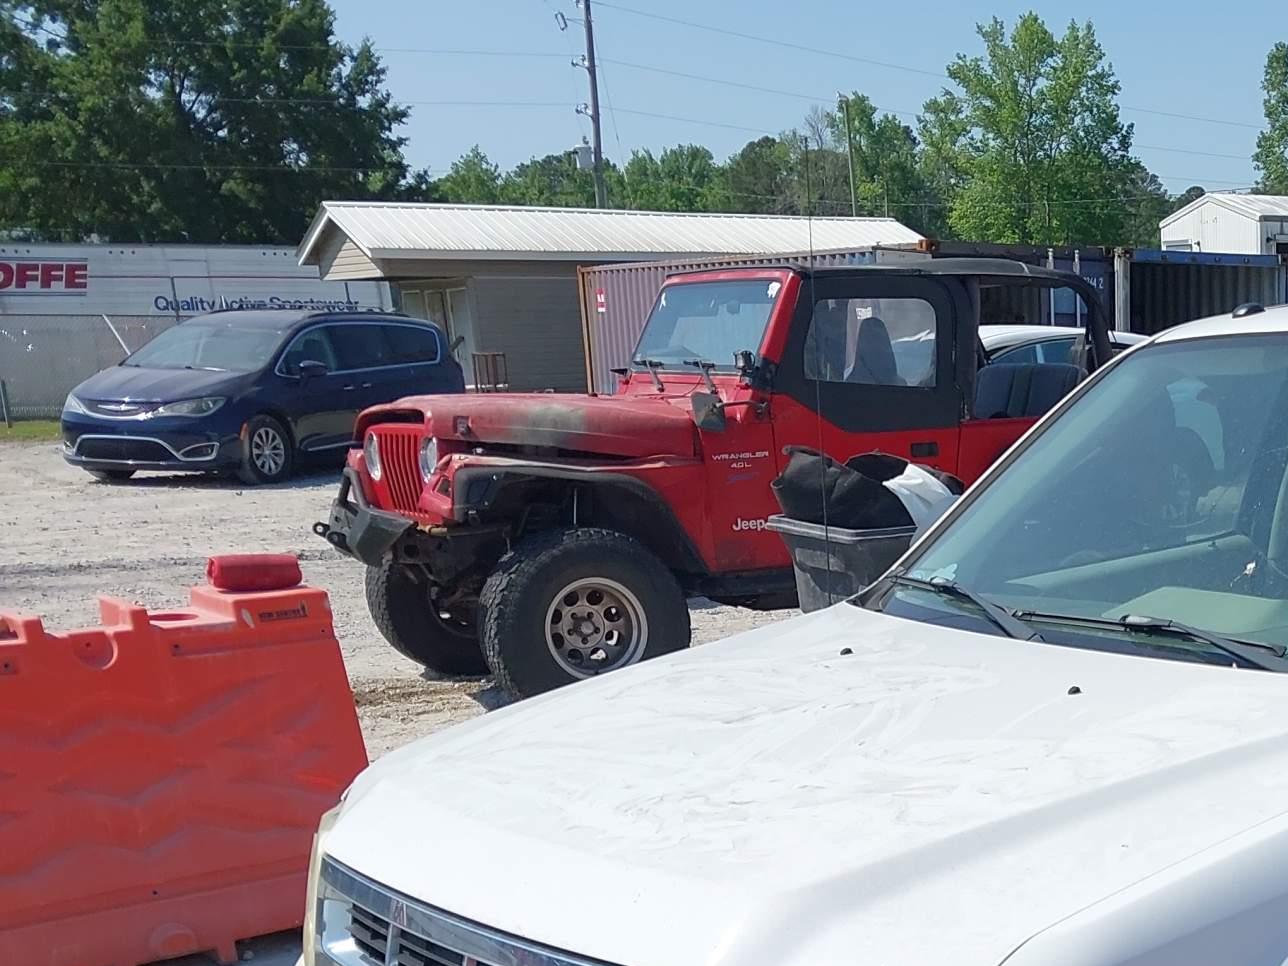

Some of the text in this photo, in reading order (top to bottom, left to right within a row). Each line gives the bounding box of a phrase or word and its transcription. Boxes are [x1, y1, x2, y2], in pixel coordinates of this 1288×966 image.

[154, 295, 216, 312] Quality
[712, 451, 769, 461] WRANGLER
[732, 517, 765, 532] Jeep
